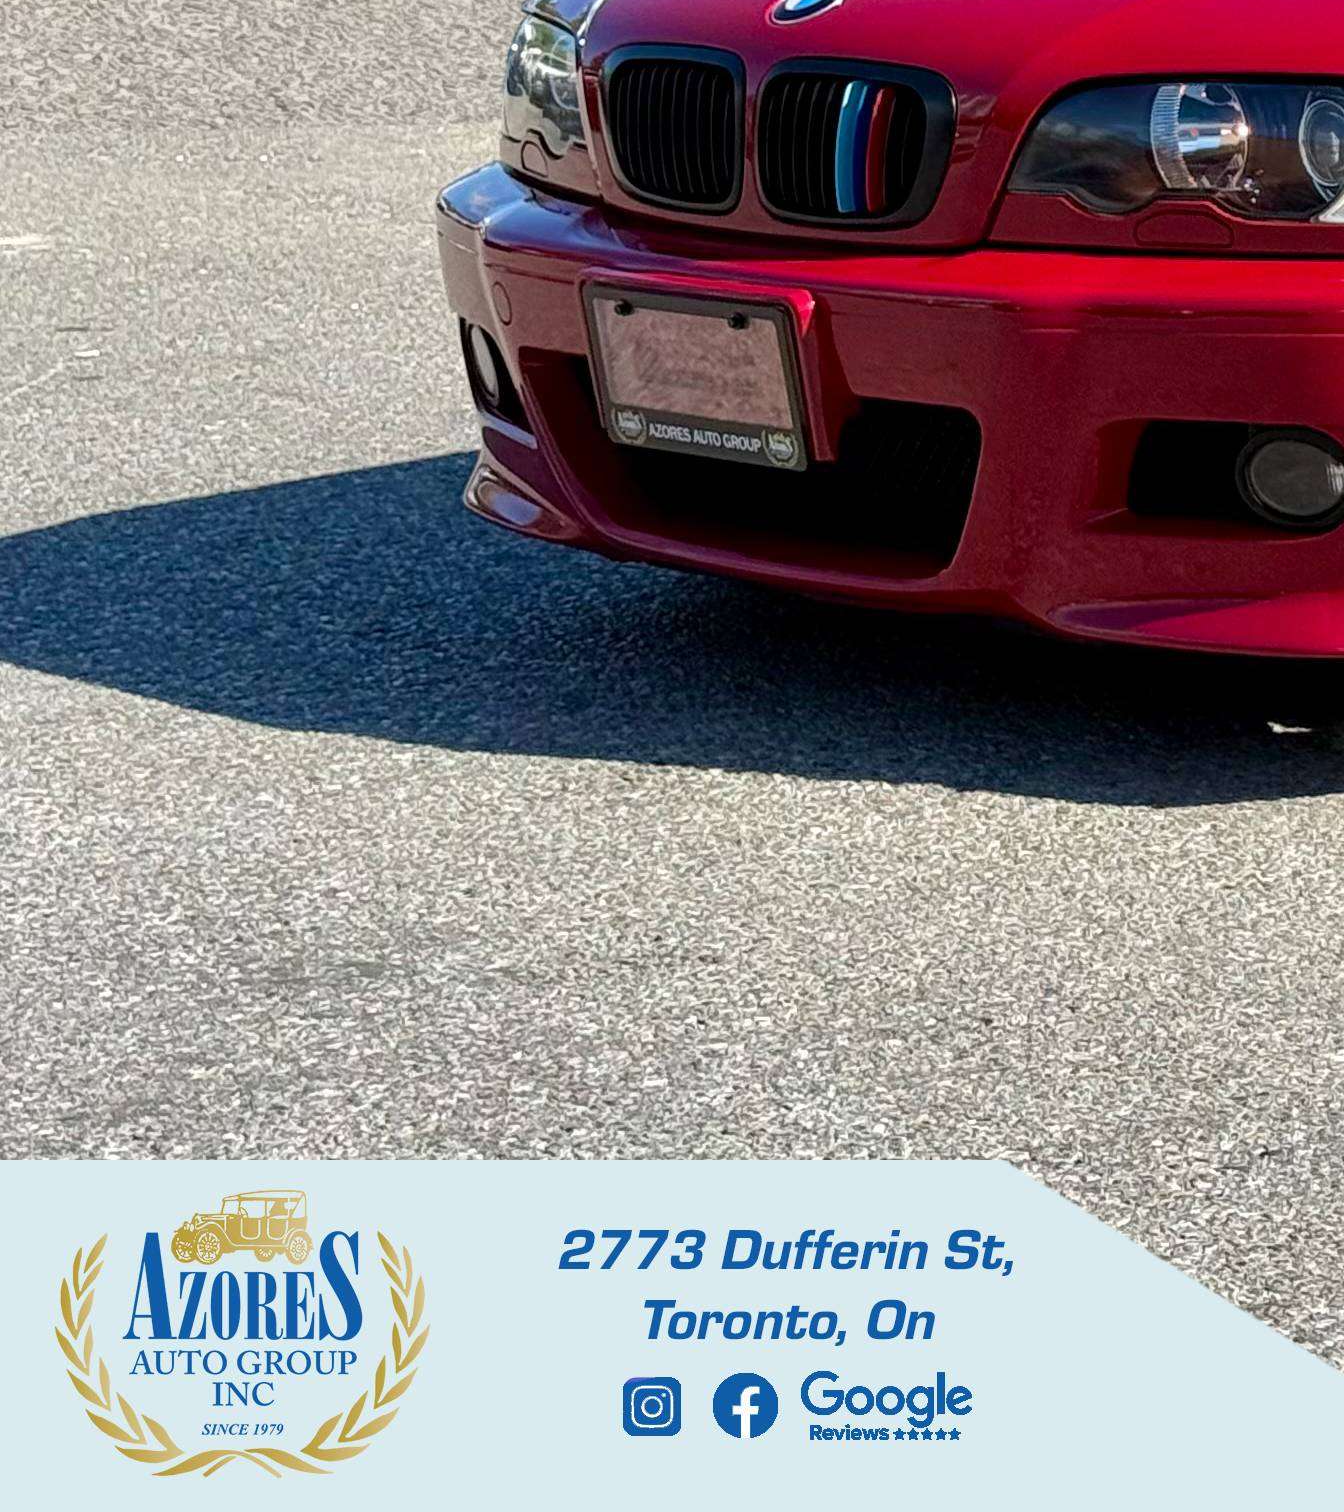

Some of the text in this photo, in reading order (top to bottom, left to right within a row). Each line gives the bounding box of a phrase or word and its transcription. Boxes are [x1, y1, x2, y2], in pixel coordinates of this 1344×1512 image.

[649, 423, 692, 443] AZORES
[693, 429, 721, 447] AUTO
[722, 434, 761, 453] GROUP
